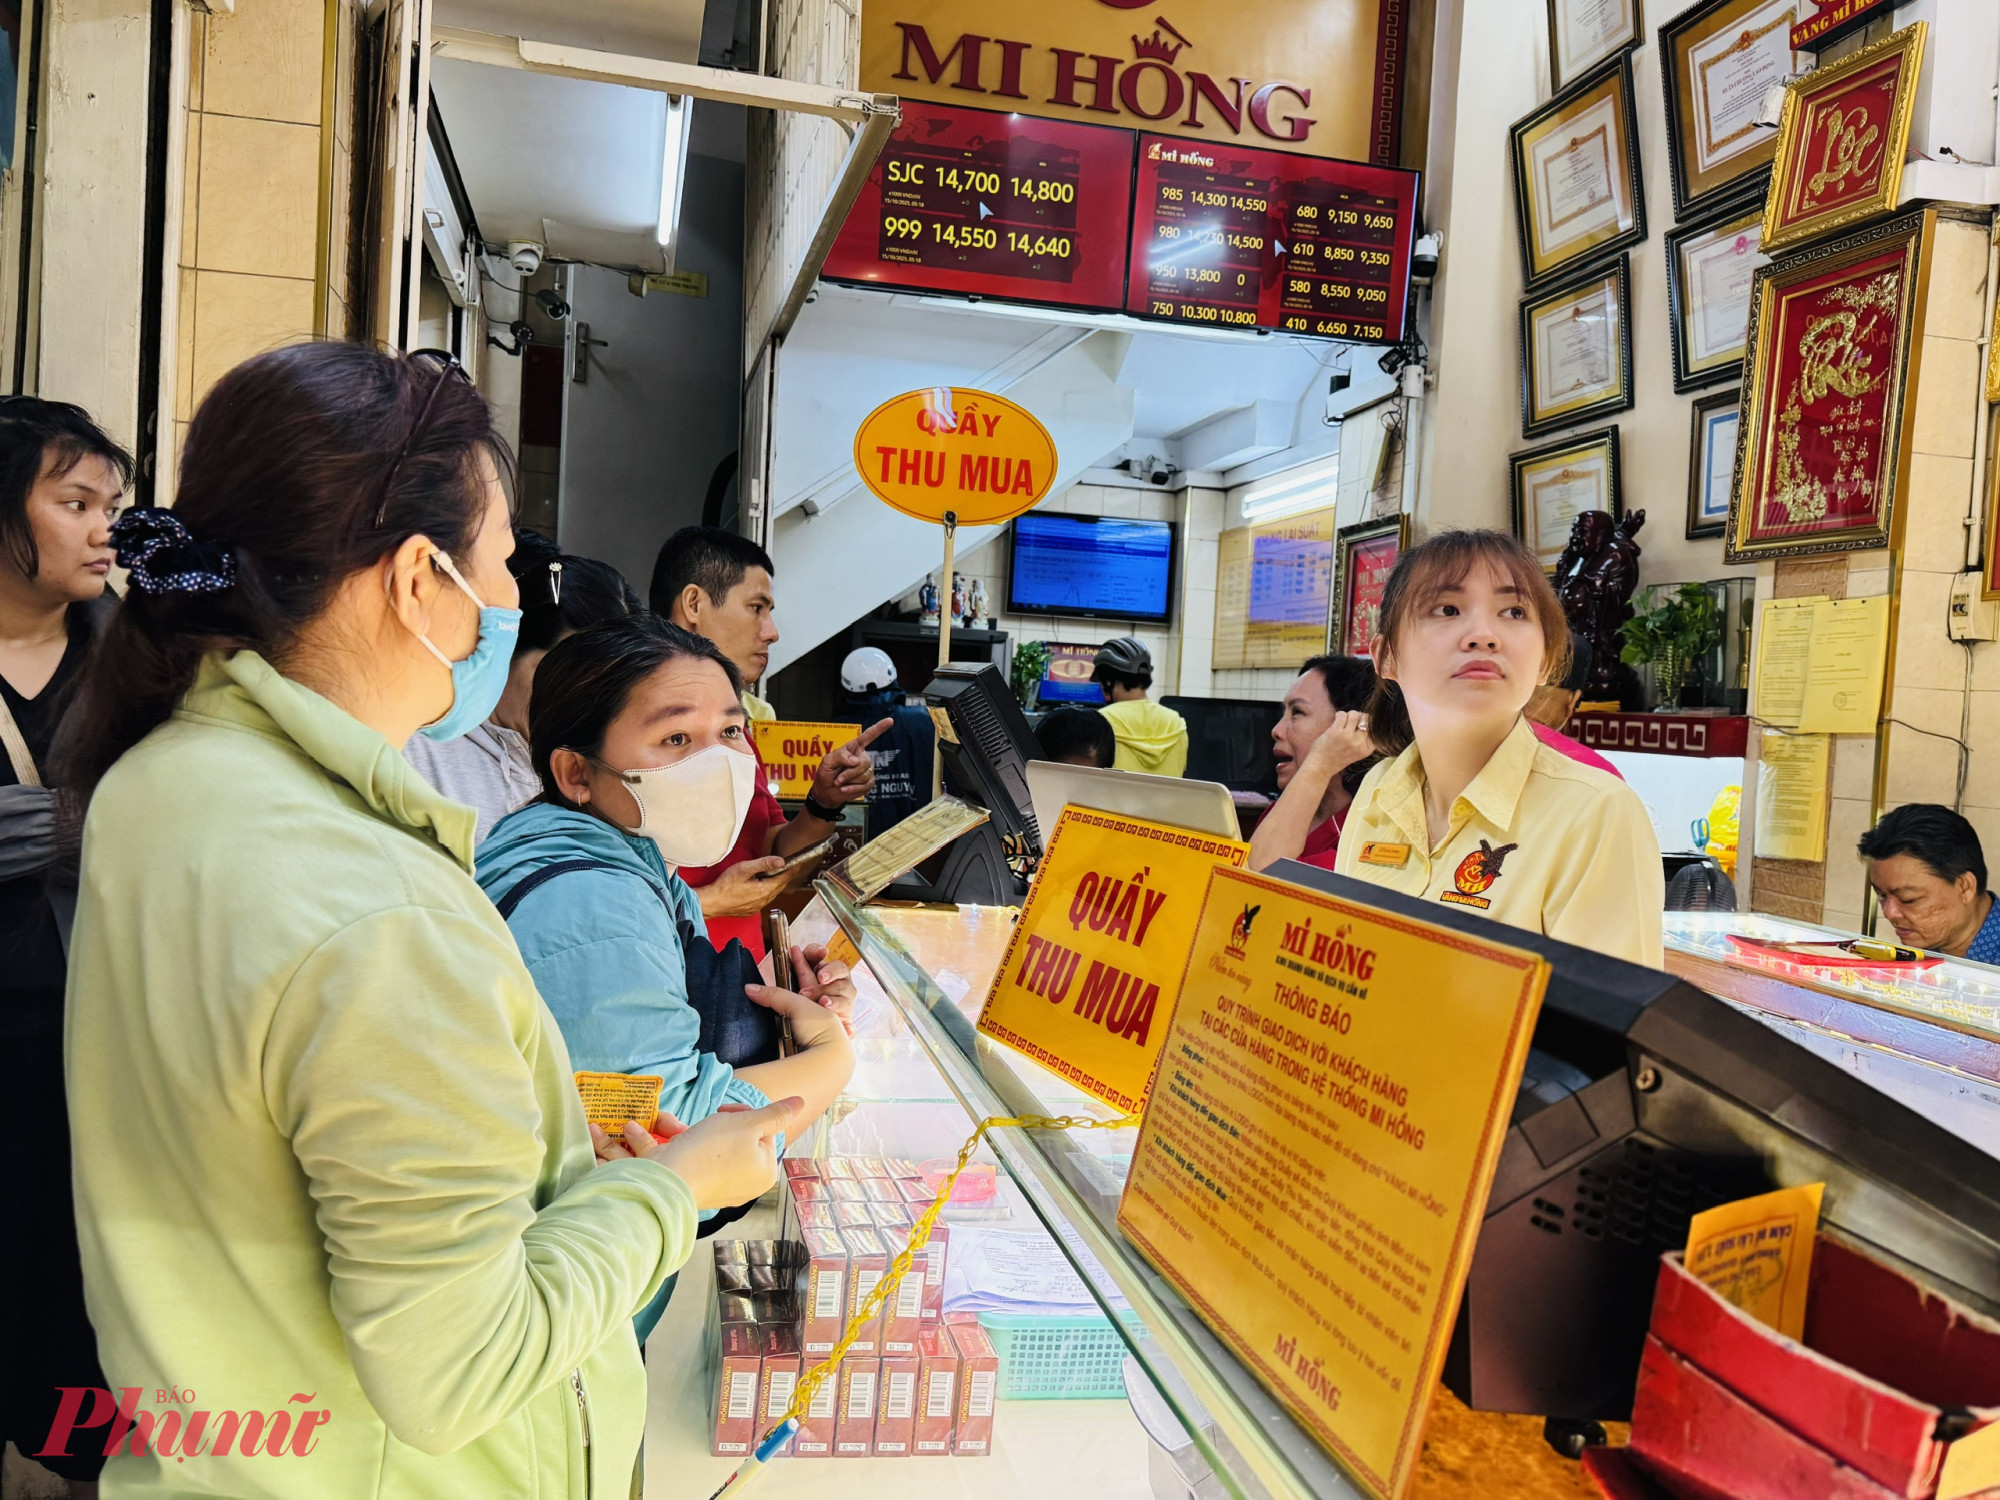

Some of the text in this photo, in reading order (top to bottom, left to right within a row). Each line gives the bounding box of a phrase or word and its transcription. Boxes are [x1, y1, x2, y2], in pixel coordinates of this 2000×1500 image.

[1792, 16, 1829, 45] VÀNG
[892, 16, 1318, 142] MI HỒNG
[888, 161, 1074, 203] SJC 14,700 14,800
[1162, 187, 1267, 212] 985 14,300 14,550
[1296, 205, 1393, 229] 680 9,150 9,650
[884, 217, 1071, 258] 999 14,550 14,640
[1159, 225, 1180, 239] 980
[1227, 234, 1264, 250] 14,500
[1293, 243, 1390, 266] 610 8,850 9,350
[1155, 264, 1245, 286] 950 13,800 0
[1289, 280, 1386, 302] 580 8,550 9,050
[1152, 301, 1174, 316] 750
[1286, 318, 1307, 331] 410
[916, 402, 1002, 438] QUẦY
[876, 446, 1034, 496] THU MUA
[782, 735, 834, 757] QUẦY
[763, 764, 817, 781] THU N
[1457, 876, 1487, 893] MH
[1068, 866, 1168, 948] QUẦY
[1310, 926, 1375, 979] HỒNG
[1015, 934, 1160, 1048] THU MUA
[1274, 982, 1351, 1034] THÔNG BÁO
[1217, 995, 1407, 1106] QUY TRÌNH GIAO DỊCH VỚI KHÁCH HÀNG
[1200, 1010, 1213, 1029] TẠI
[1212, 1017, 1230, 1038] CÁC
[1230, 1025, 1247, 1049] CỬA
[1248, 1038, 1274, 1064] HÀNG
[1276, 1052, 1309, 1084] TRONG
[1310, 1072, 1327, 1096] HỆ
[1329, 1081, 1368, 1117] THỐNG
[1370, 1105, 1384, 1125] MI
[1296, 1355, 1340, 1410] HỒNG
